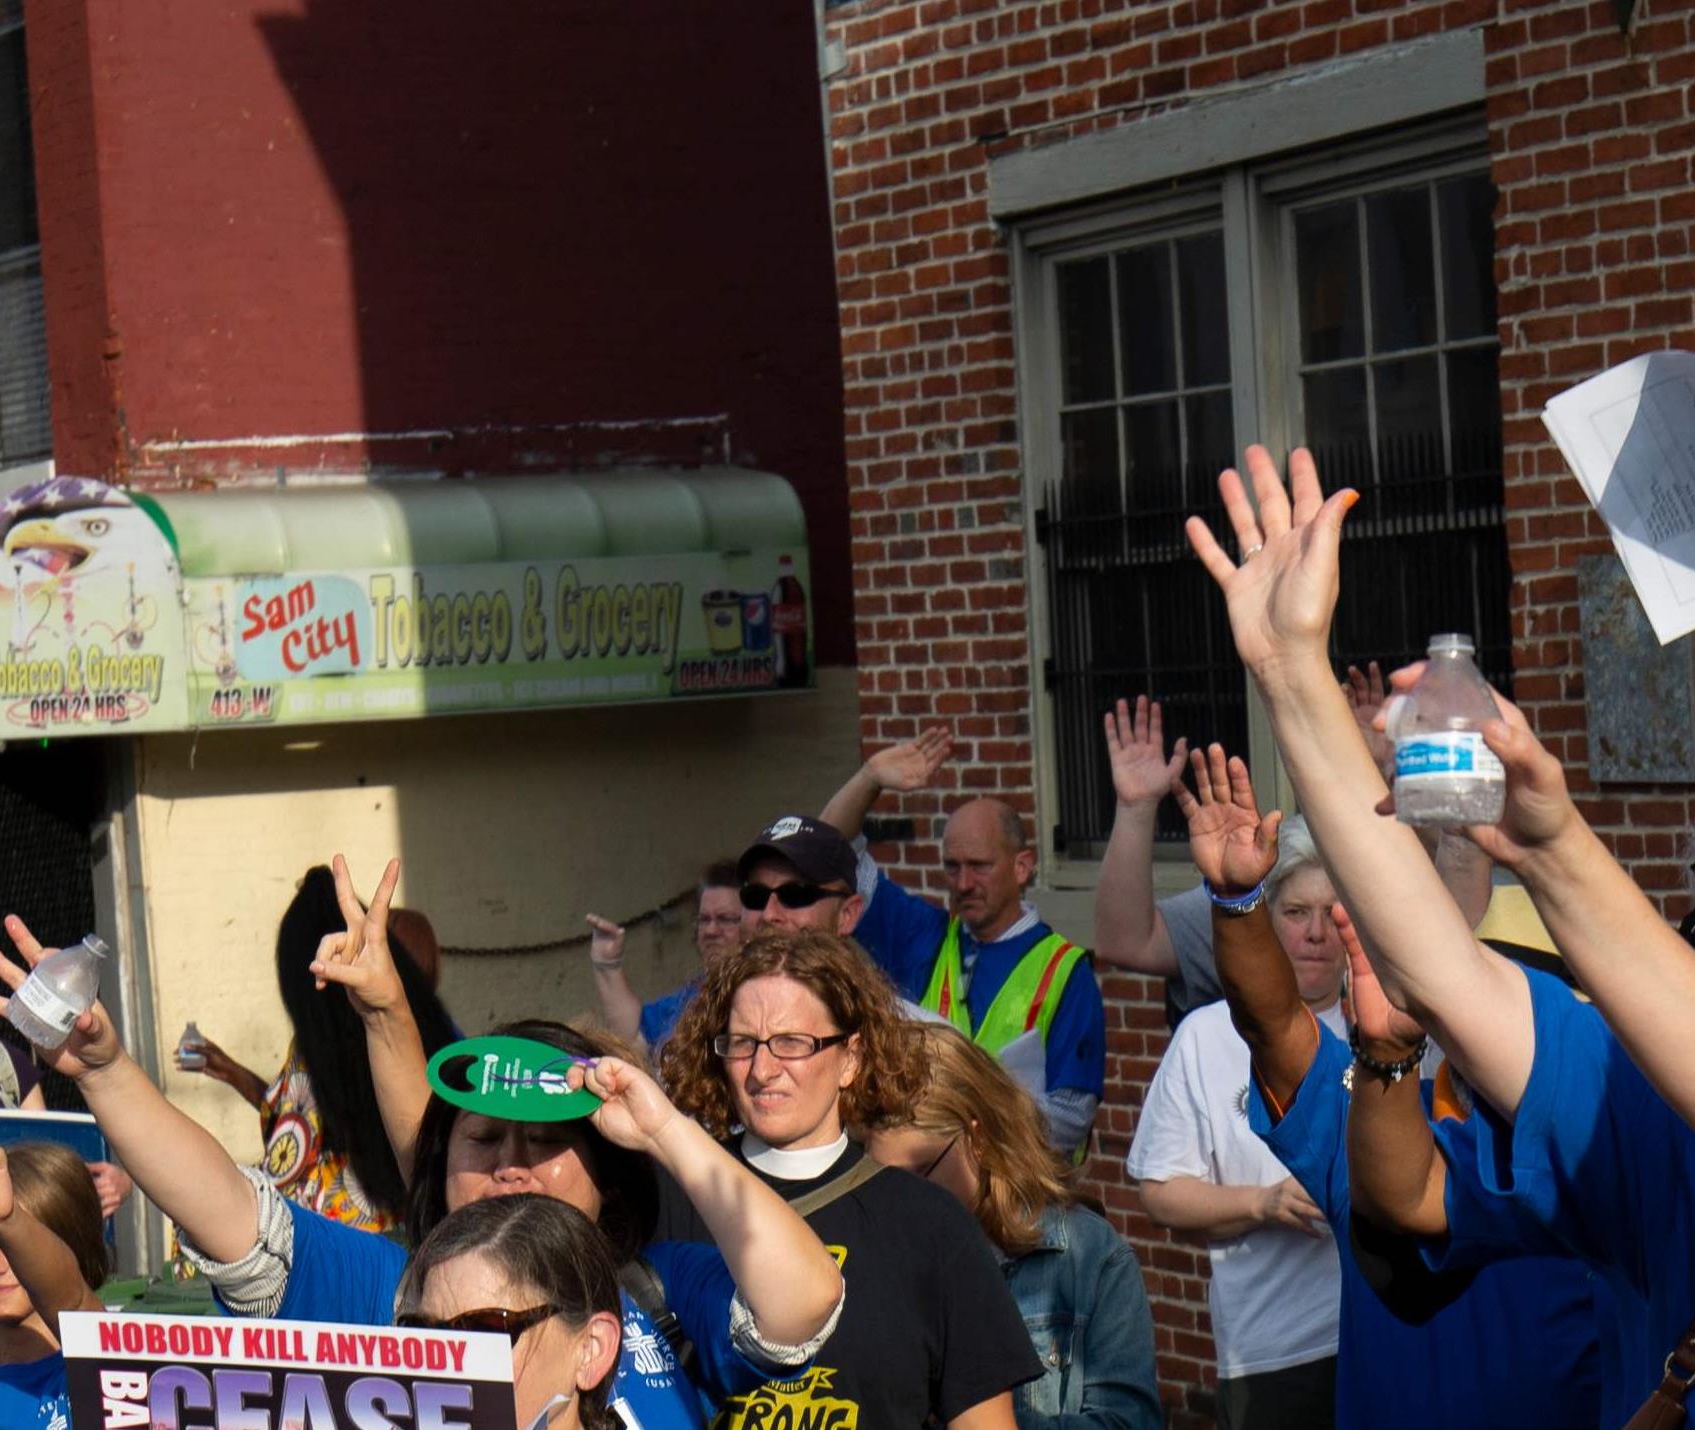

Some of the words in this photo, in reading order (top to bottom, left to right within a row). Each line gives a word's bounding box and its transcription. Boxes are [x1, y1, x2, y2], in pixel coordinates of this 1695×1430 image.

[242, 580, 315, 642] Sam
[281, 610, 360, 672] City
[370, 572, 513, 668] Tobacco
[521, 566, 546, 661] &
[557, 564, 683, 675] Grocery
[67, 645, 83, 692] &
[87, 643, 164, 704] Grocery
[680, 660, 717, 689] OPEN
[743, 656, 771, 684] HRS
[30, 697, 68, 723] OPEN
[95, 694, 126, 720] HRS
[99, 1321, 232, 1358] NOBODY
[243, 1328, 307, 1362] KILL
[315, 1332, 467, 1372] ANYBODY
